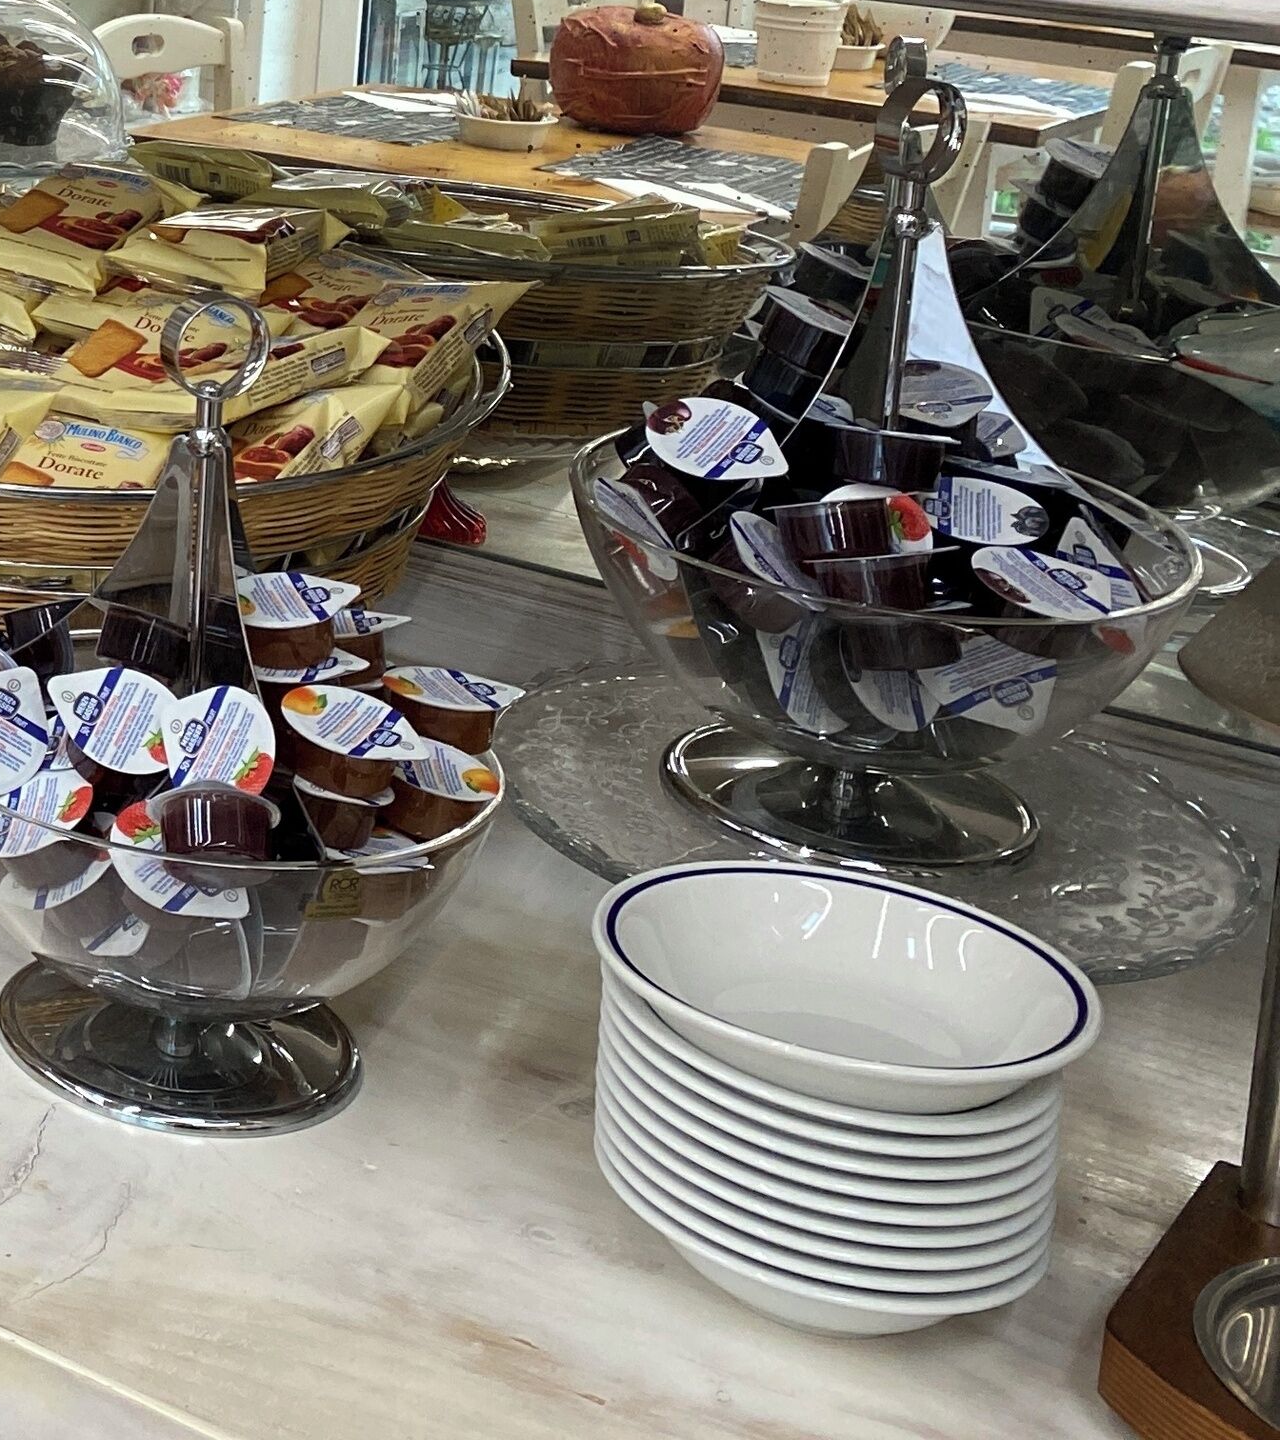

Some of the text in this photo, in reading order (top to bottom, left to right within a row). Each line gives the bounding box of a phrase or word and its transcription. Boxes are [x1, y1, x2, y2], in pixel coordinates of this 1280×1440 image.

[56, 187, 112, 209] Dorate
[207, 305, 236, 323] IANCO
[66, 423, 143, 449] MULINO BIANCO
[37, 456, 105, 480] Dorate
